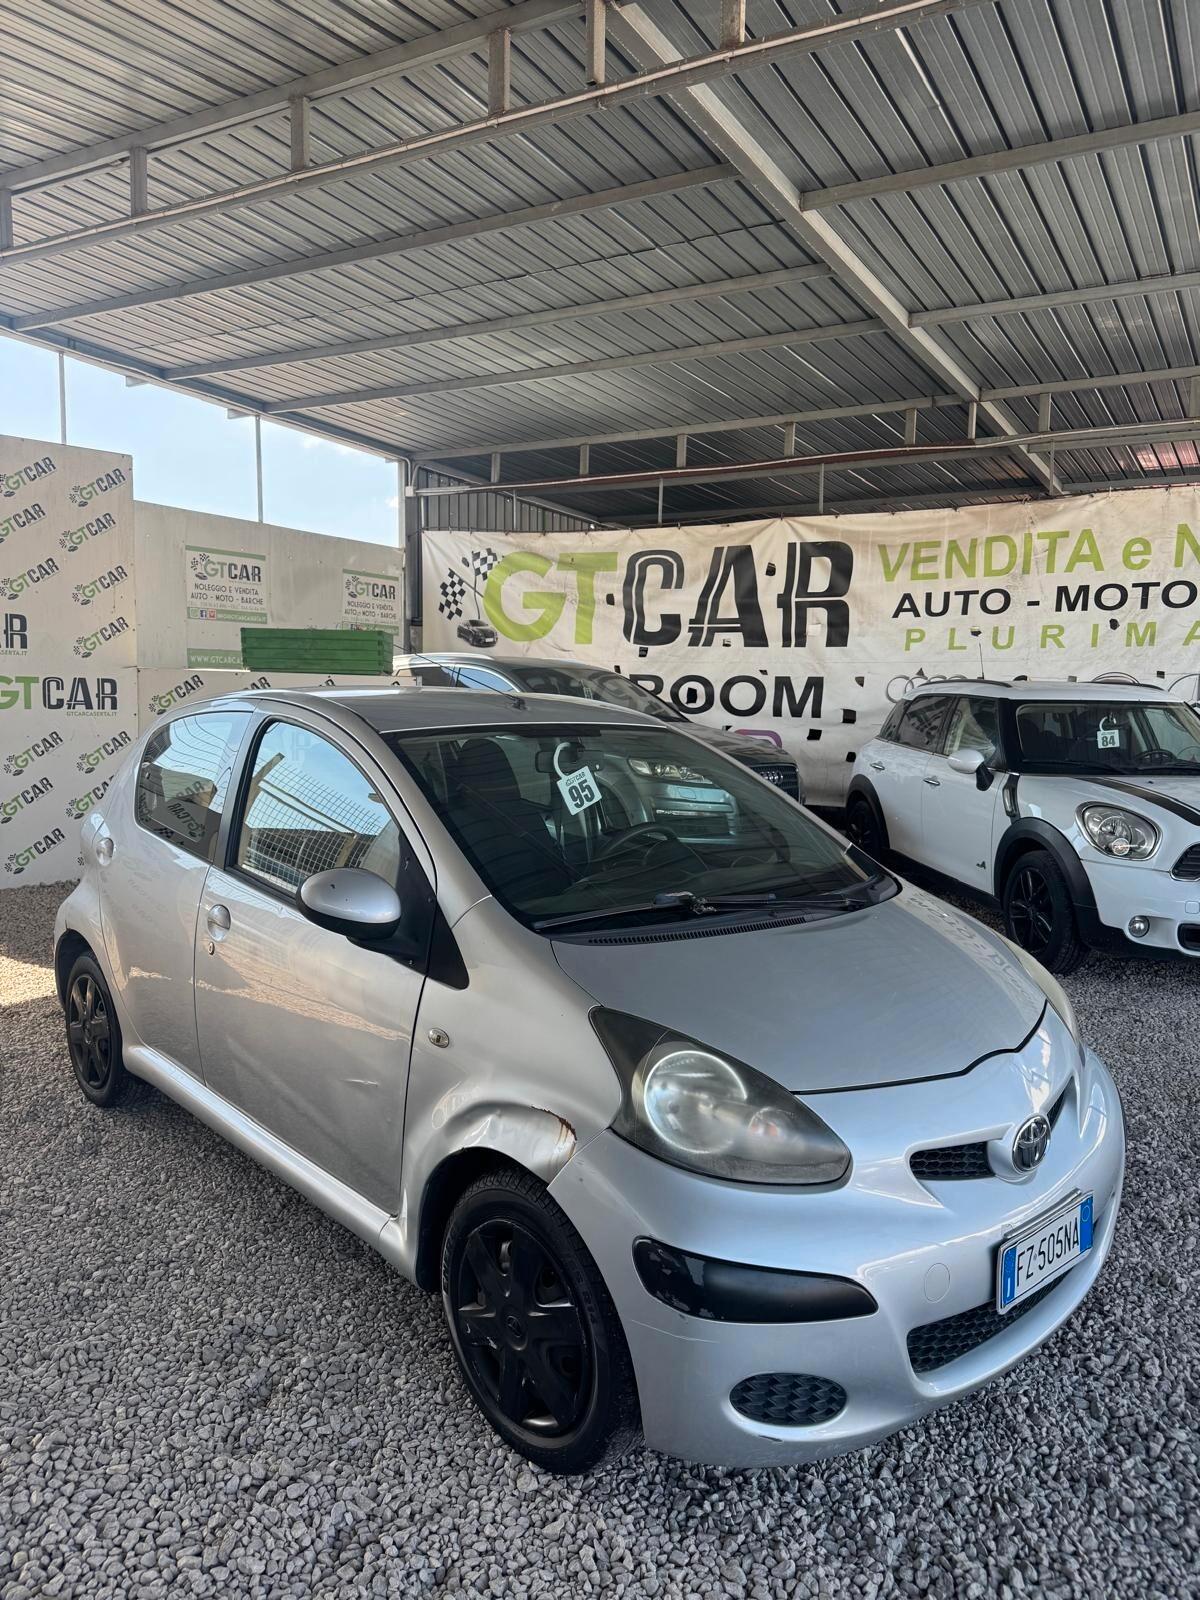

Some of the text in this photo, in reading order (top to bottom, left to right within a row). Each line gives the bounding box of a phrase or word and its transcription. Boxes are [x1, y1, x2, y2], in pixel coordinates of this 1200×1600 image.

[5, 457, 56, 491] GTCAR
[79, 468, 126, 501] GTCAR
[69, 513, 116, 546] GTCAR
[203, 560, 261, 582] GTCAR
[877, 528, 1105, 583] VENDITA
[1122, 536, 1152, 570] e
[9, 557, 60, 593] GTCAR
[81, 565, 128, 599] GTCAR
[194, 583, 259, 596] NOLEGGIO E VENDITA
[355, 581, 396, 600] GTCAR
[215, 595, 234, 603] MOTO
[241, 597, 264, 605] BARCHE
[892, 588, 1011, 619] AUTO
[1055, 580, 1198, 612] MOTO
[82, 616, 129, 652] GTCAR
[0, 676, 118, 710] GTCAR
[157, 674, 205, 708] GTCAR
[14, 731, 64, 769] GTCAR
[86, 730, 132, 767] GTCAR
[1101, 735, 1116, 747] 84
[2, 777, 54, 816] GTCAR
[568, 779, 596, 809] 95
[15, 827, 66, 867] GTCAR
